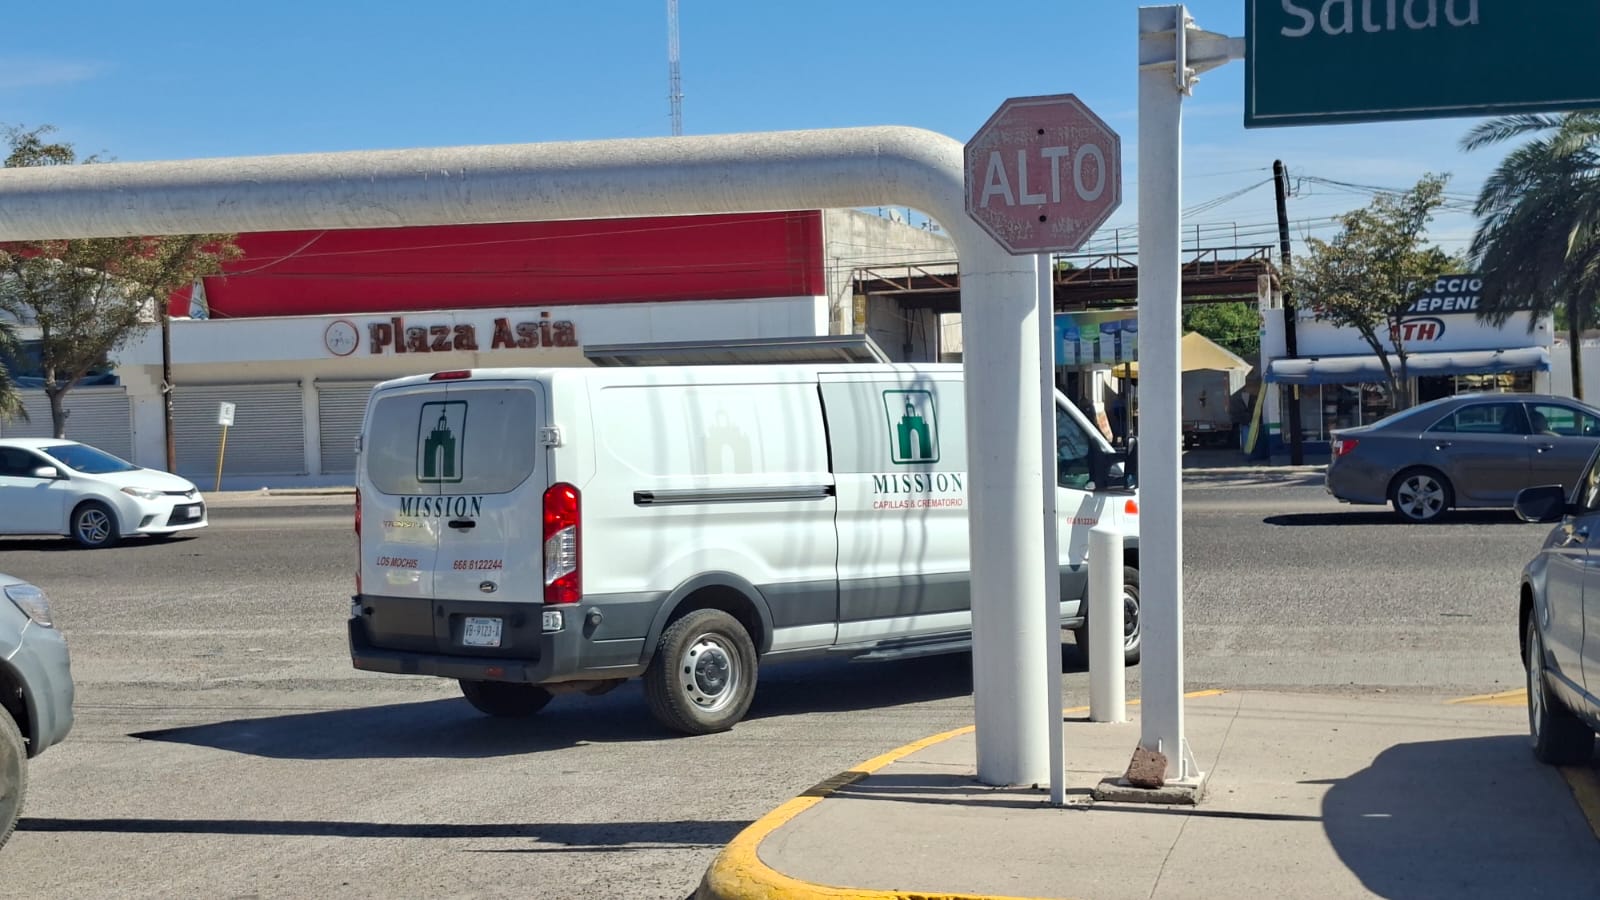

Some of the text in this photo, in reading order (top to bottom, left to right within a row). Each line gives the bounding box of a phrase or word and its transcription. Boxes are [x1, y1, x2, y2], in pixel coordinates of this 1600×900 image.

[980, 143, 1106, 208] ALTO
[491, 311, 578, 349] Asia
[872, 473, 963, 494] MISSION
[399, 496, 483, 518] MISSION
[873, 500, 909, 509] CAPILLAS
[918, 498, 963, 508] CREMATORIO
[376, 556, 419, 569] LOS MOCHIS
[469, 559, 503, 570] 8122244
